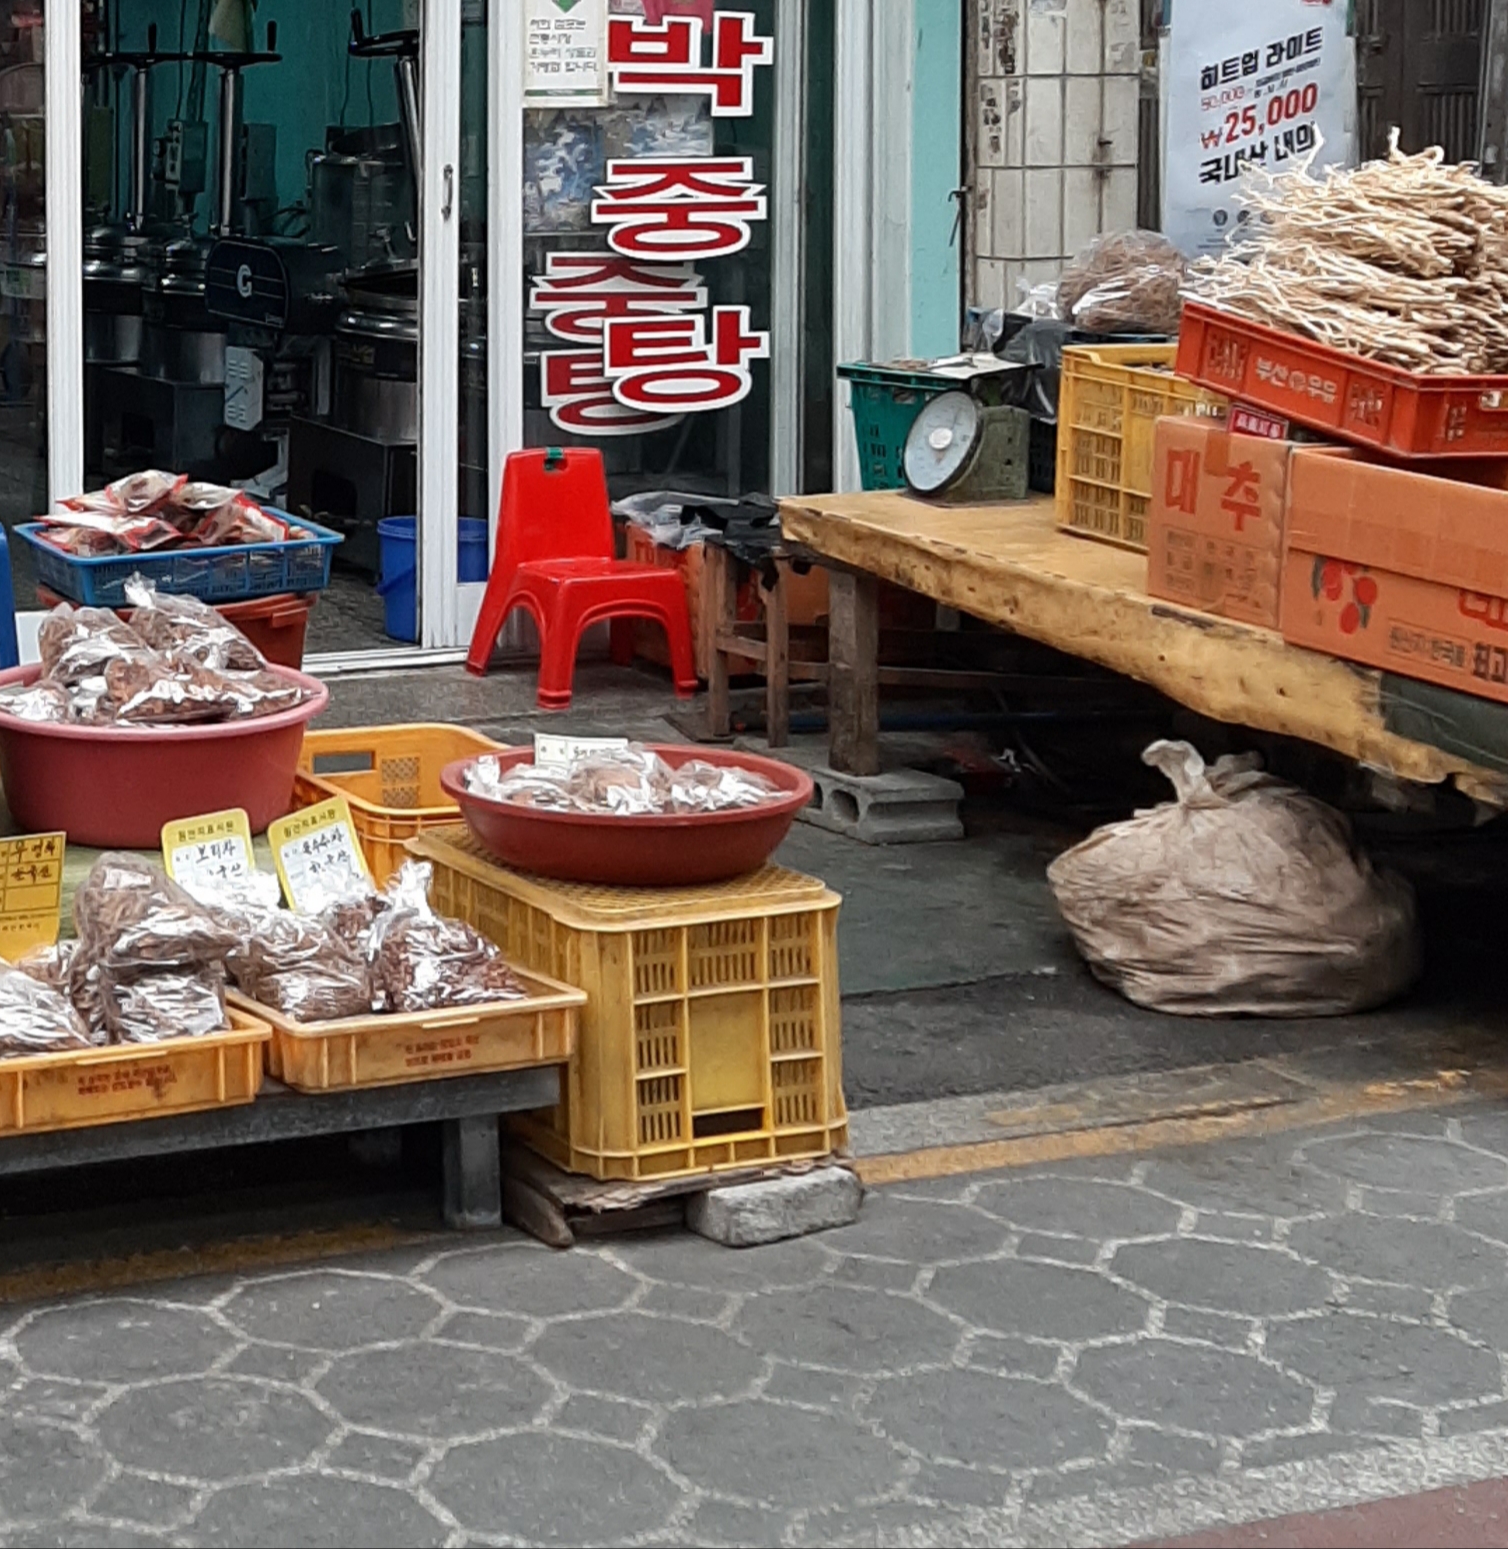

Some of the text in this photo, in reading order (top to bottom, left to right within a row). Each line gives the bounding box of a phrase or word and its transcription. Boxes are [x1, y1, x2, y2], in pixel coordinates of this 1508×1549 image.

[1200, 49, 1259, 91] 히트업
[1266, 26, 1324, 68] 라이트
[1164, 448, 1264, 531] 대추
